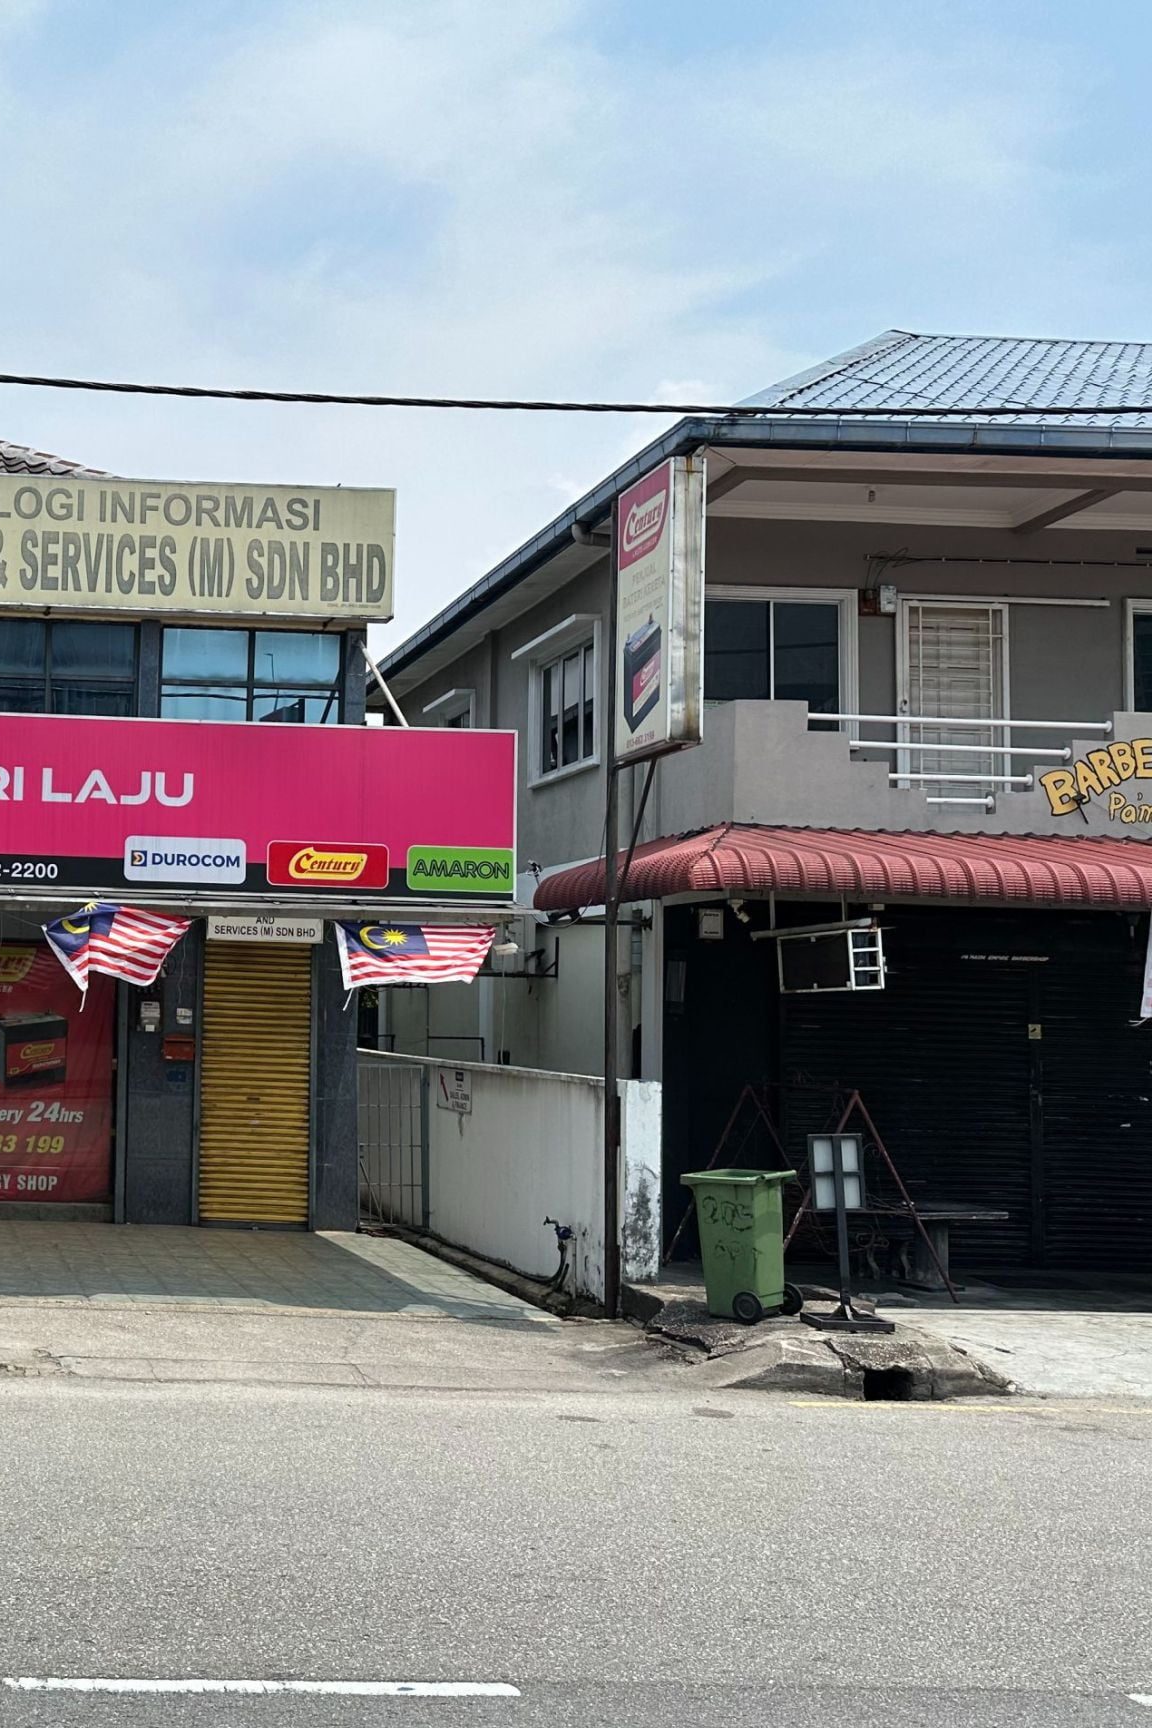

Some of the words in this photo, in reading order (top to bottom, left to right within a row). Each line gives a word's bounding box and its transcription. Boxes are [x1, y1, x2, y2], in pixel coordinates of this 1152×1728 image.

[98, 489, 321, 532] INFORMASI
[19, 528, 178, 597] SERVICES
[188, 535, 236, 598] (M)
[246, 538, 311, 601] SDN
[320, 542, 387, 604] BHD
[41, 767, 195, 808] LAJU
[1039, 738, 1152, 817] BARBE
[151, 852, 241, 869] DUROCOM
[294, 852, 361, 876] Century
[413, 858, 509, 880] AMARON
[214, 925, 258, 936] SERVICES
[260, 925, 274, 937] (M)
[276, 926, 294, 937] SDN
[296, 928, 316, 938] BHD
[255, 916, 275, 925] AND
[26, 1101, 84, 1123] 24hrs
[25, 1135, 65, 1154] 199
[17, 1174, 58, 1191] SHOP
